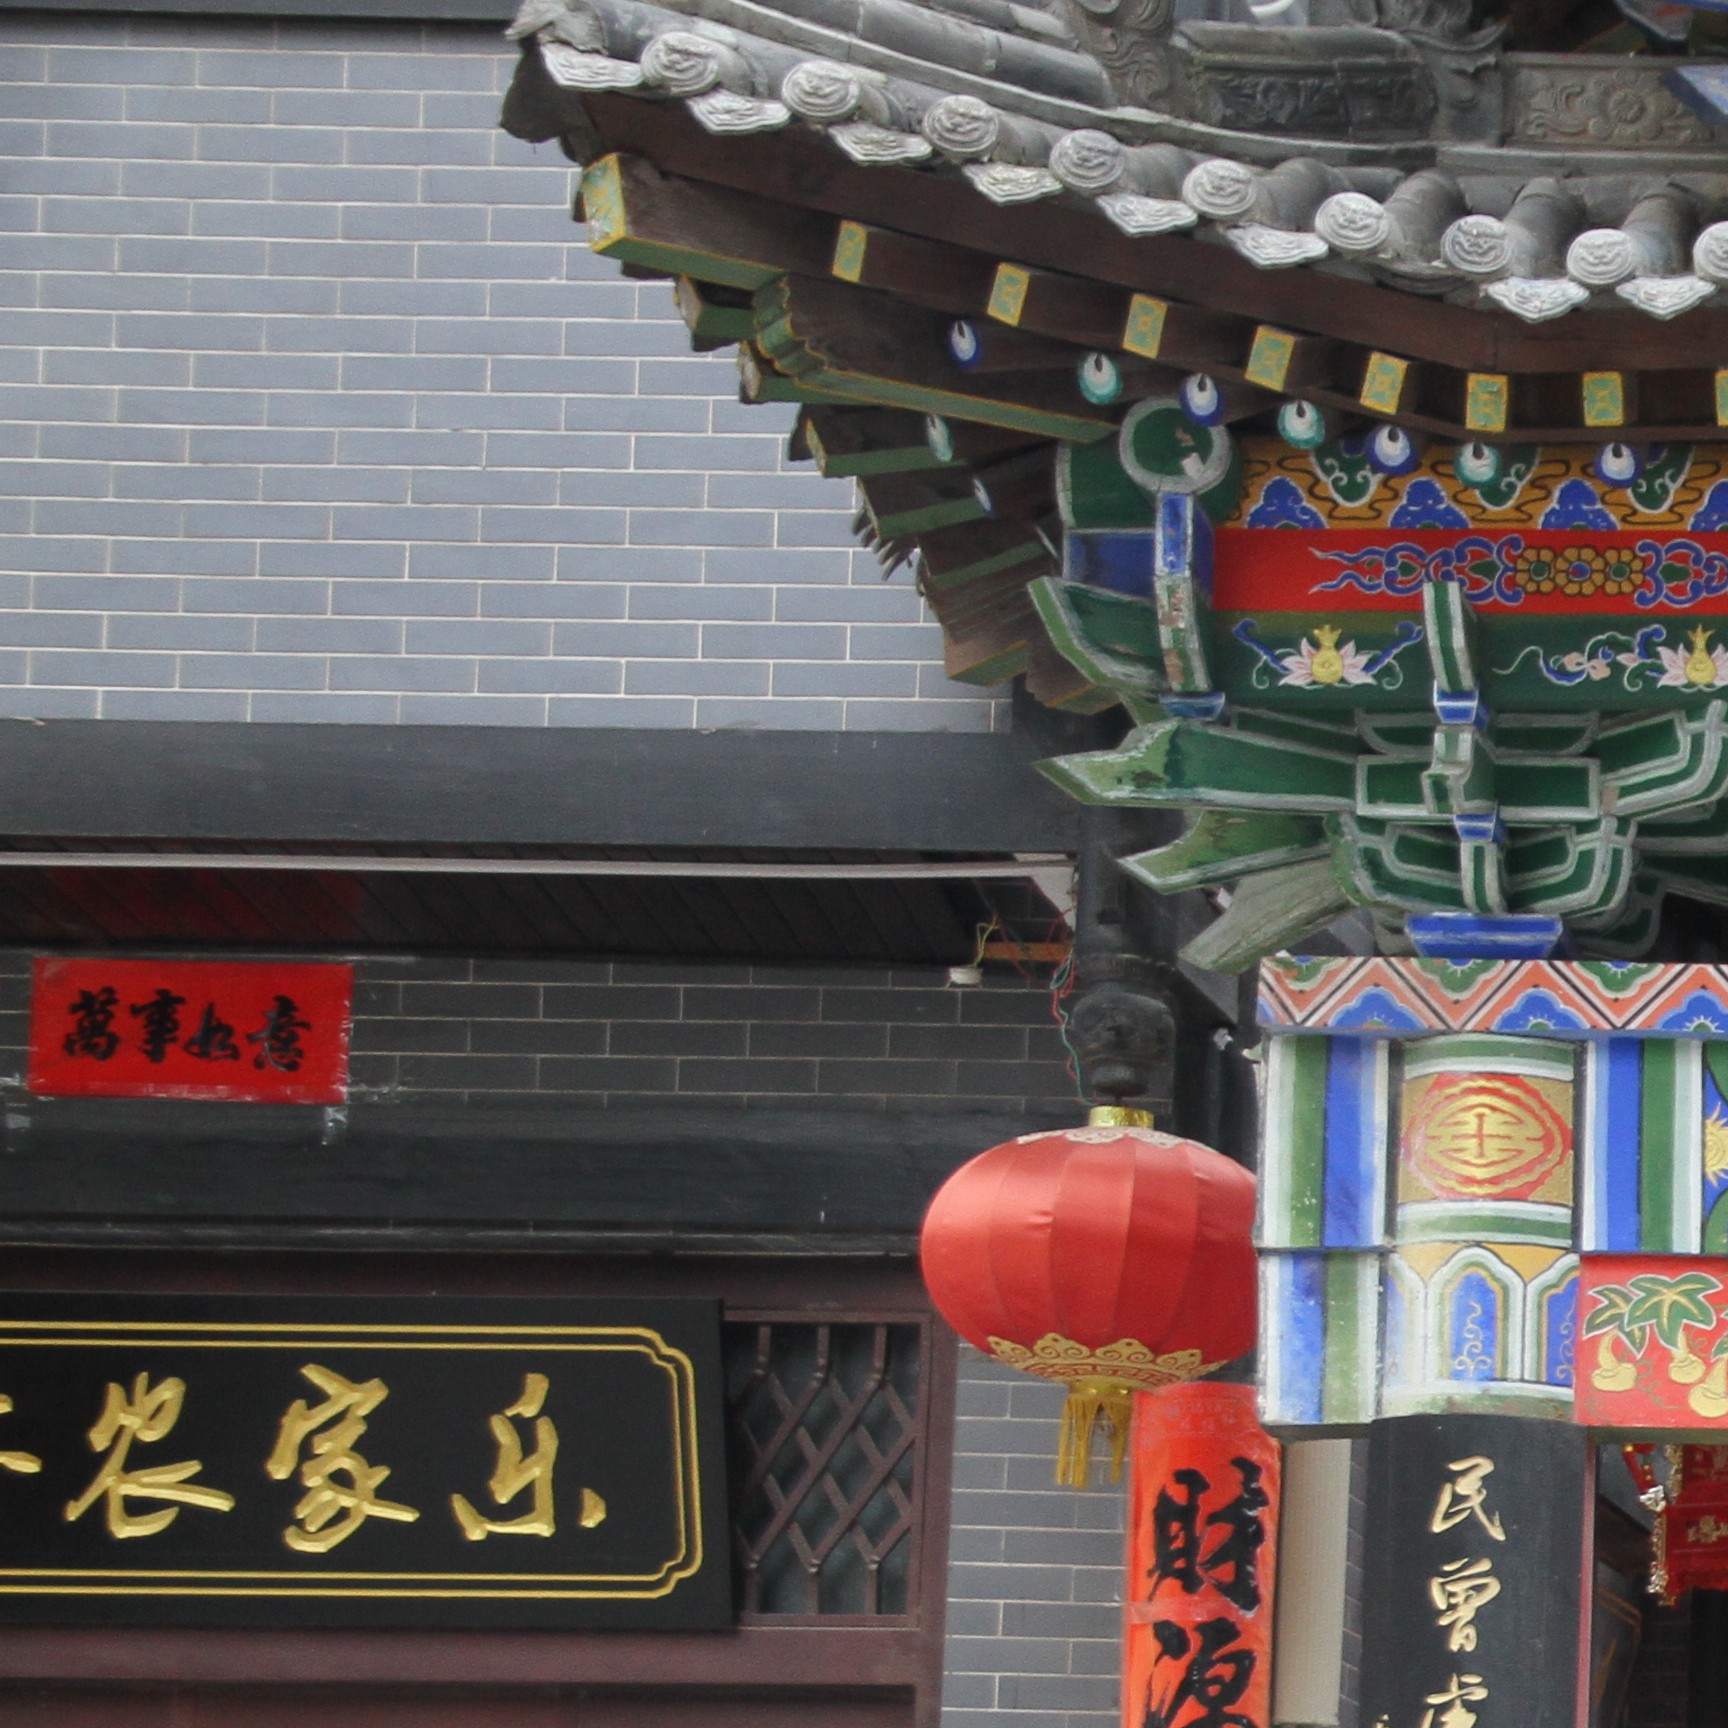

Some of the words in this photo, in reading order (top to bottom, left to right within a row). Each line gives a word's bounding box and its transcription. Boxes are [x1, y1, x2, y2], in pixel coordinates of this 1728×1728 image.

[62, 988, 313, 1074] 萬事如意
[0, 1364, 606, 1553] 农家乐
